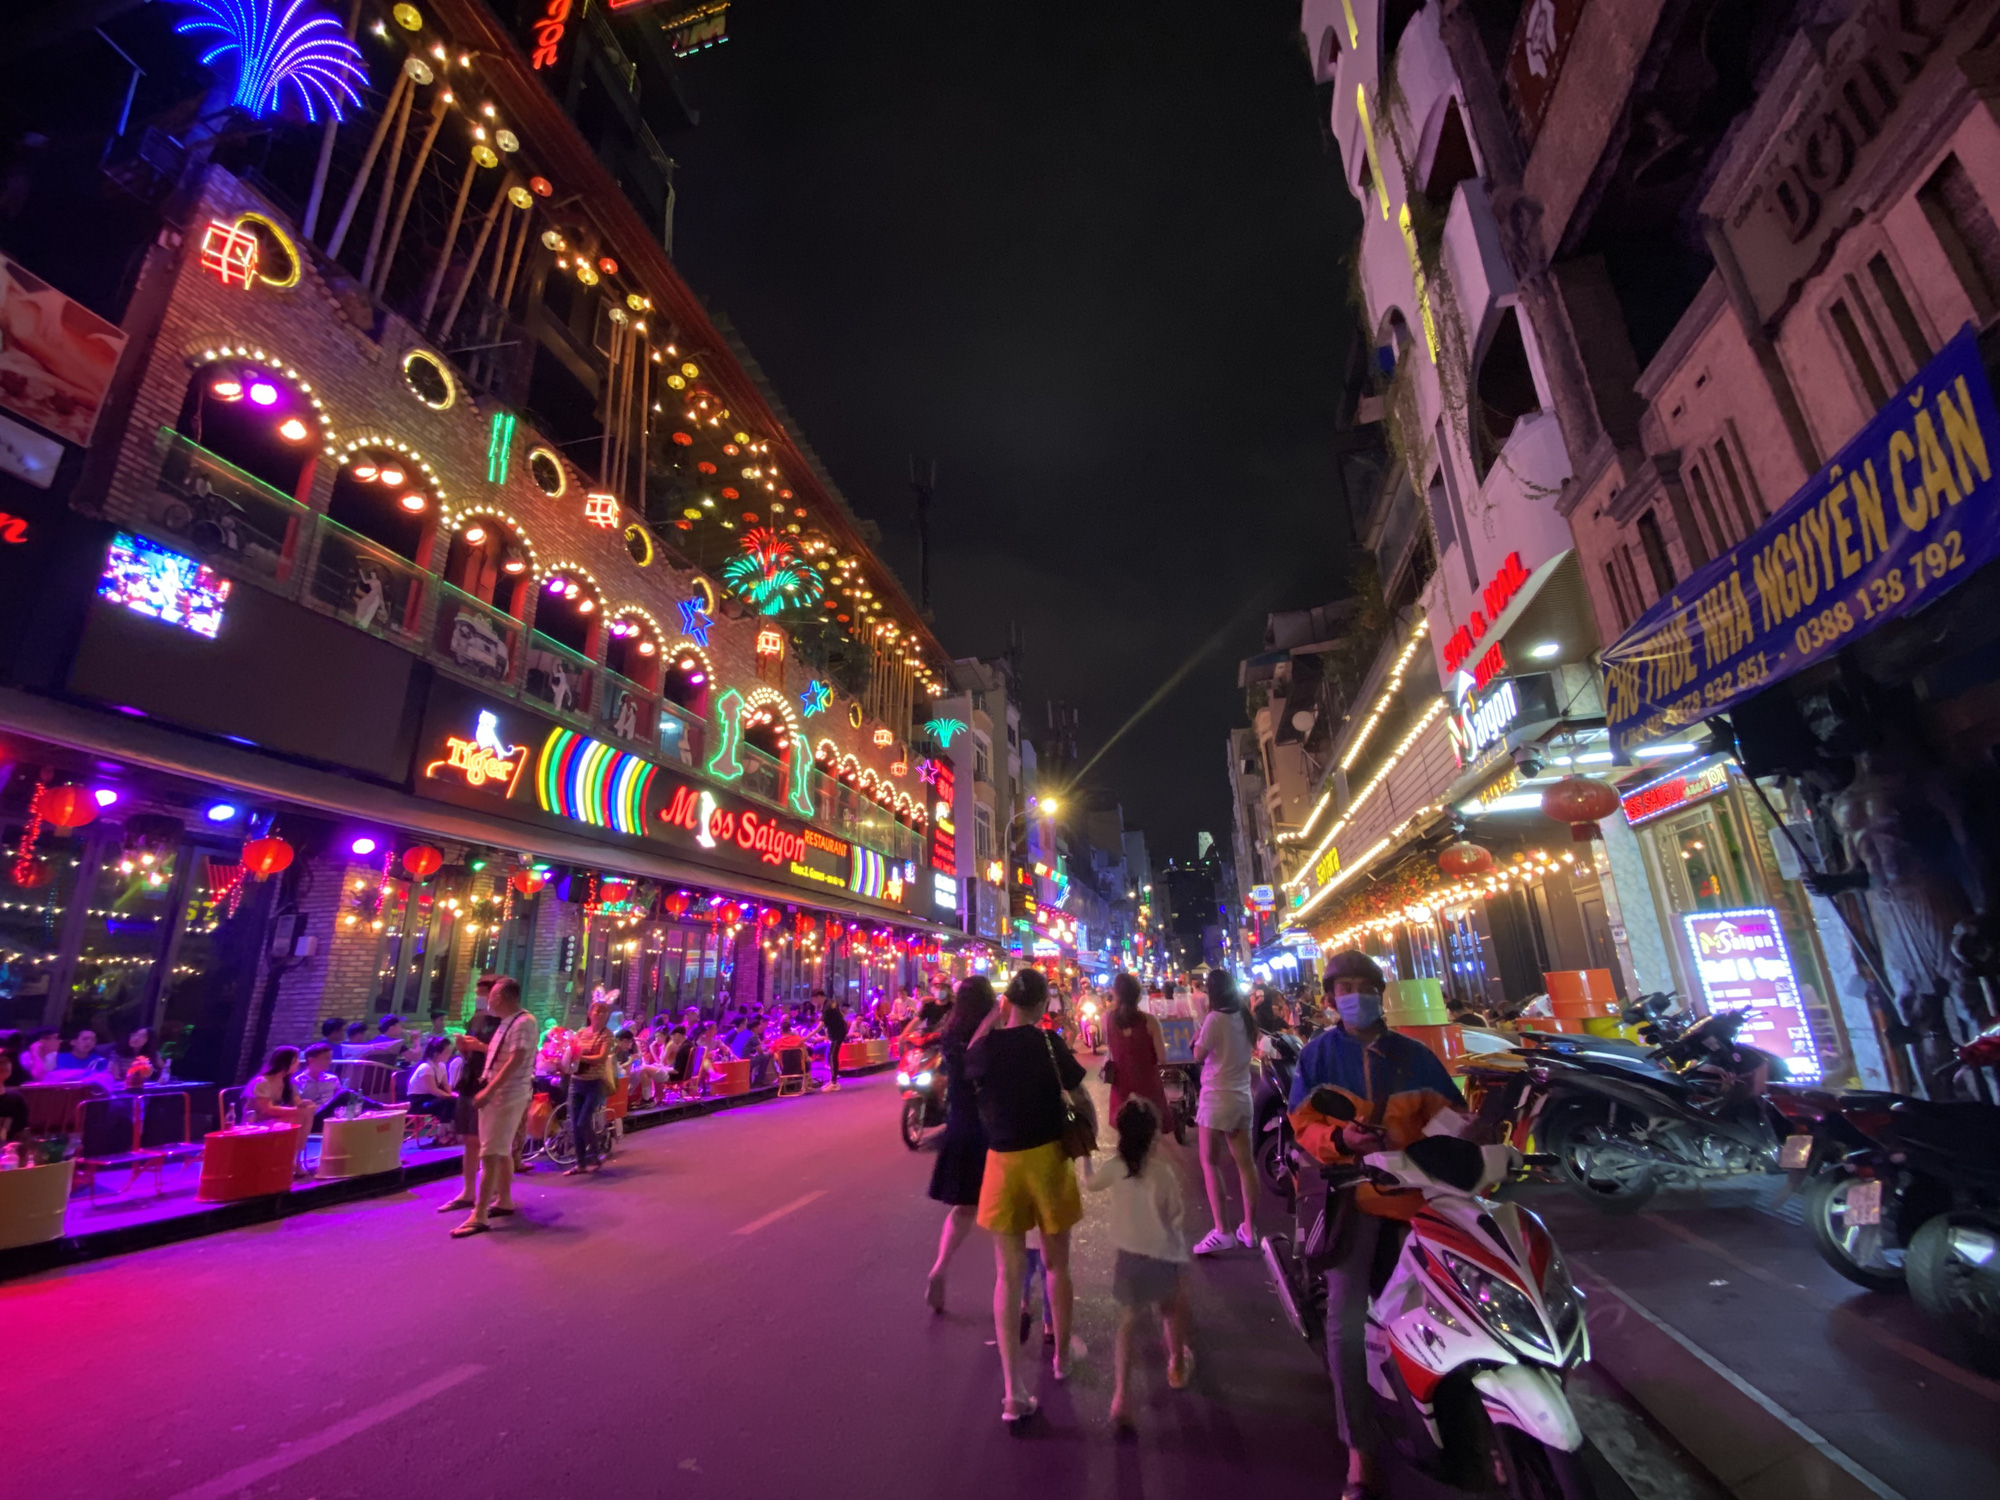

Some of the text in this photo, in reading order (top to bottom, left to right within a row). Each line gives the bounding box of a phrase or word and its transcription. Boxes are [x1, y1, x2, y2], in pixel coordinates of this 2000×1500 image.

[1641, 595, 1698, 705] THUÊ
[1753, 457, 1889, 633] NGUYÊN
[1889, 373, 1992, 532] CĂN
[1443, 551, 1532, 674] SPA & NAIL
[1704, 671, 1735, 707] 932
[1737, 651, 1771, 690] 851
[1795, 600, 1855, 655] 0388
[1856, 568, 1907, 622] 138
[1909, 529, 1966, 589] 792
[1473, 640, 1506, 692] HOTEL
[446, 736, 515, 786] Tiger
[1642, 776, 1687, 814] SAIGON
[736, 811, 806, 865] Saigon
[804, 829, 848, 858] RESTAURANT
